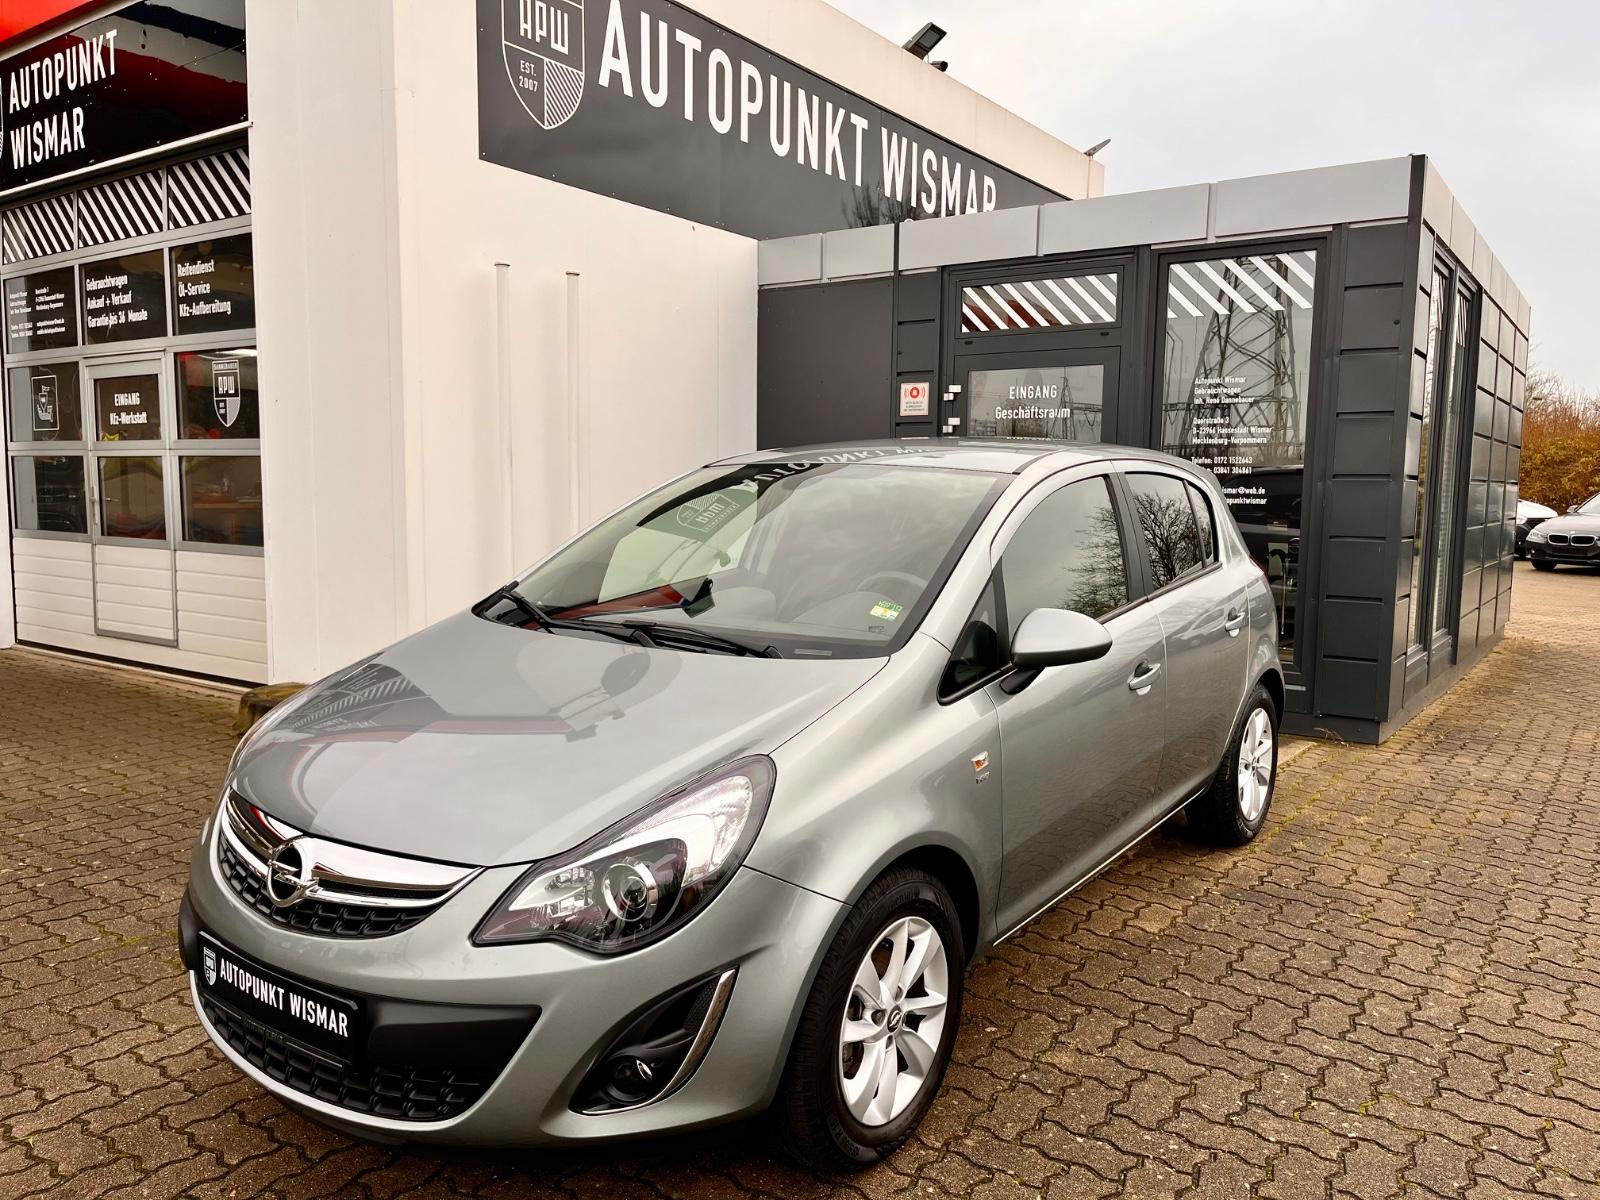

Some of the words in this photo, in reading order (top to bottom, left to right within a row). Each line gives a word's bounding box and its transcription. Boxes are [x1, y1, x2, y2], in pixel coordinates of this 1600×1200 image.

[9, 29, 117, 114] AUTOPUNKT
[520, 60, 537, 77] EST.
[519, 75, 538, 92] 2007
[598, 0, 869, 187] AUTOPUNKT
[10, 106, 86, 170] WISMAR
[177, 259, 215, 278] Reifendienst
[86, 275, 128, 291] Gebrauchtwagen
[178, 280, 211, 297] Öl-Service
[87, 294, 105, 310] Ankauf
[105, 297, 111, 306] +
[111, 290, 132, 305] Verkauf
[179, 299, 232, 317] Kfz-Aufbereitung
[118, 310, 126, 323] 36
[127, 309, 148, 322] Monate
[1194, 376, 1223, 385] Autopunkt
[1225, 375, 1247, 383] Wismar
[114, 392, 140, 406] EINGANG
[1009, 384, 1057, 400] EINGANG
[1194, 387, 1242, 395] Gebrauchtwagen
[110, 411, 147, 425] Kfz-Werkstatt
[995, 405, 1071, 420] Geschäftsraum
[1217, 426, 1249, 434] Hansestadt
[1213, 456, 1228, 464] 0172
[220, 957, 285, 1011] AUTOPUNKT
[289, 992, 349, 1038] WISMAR
